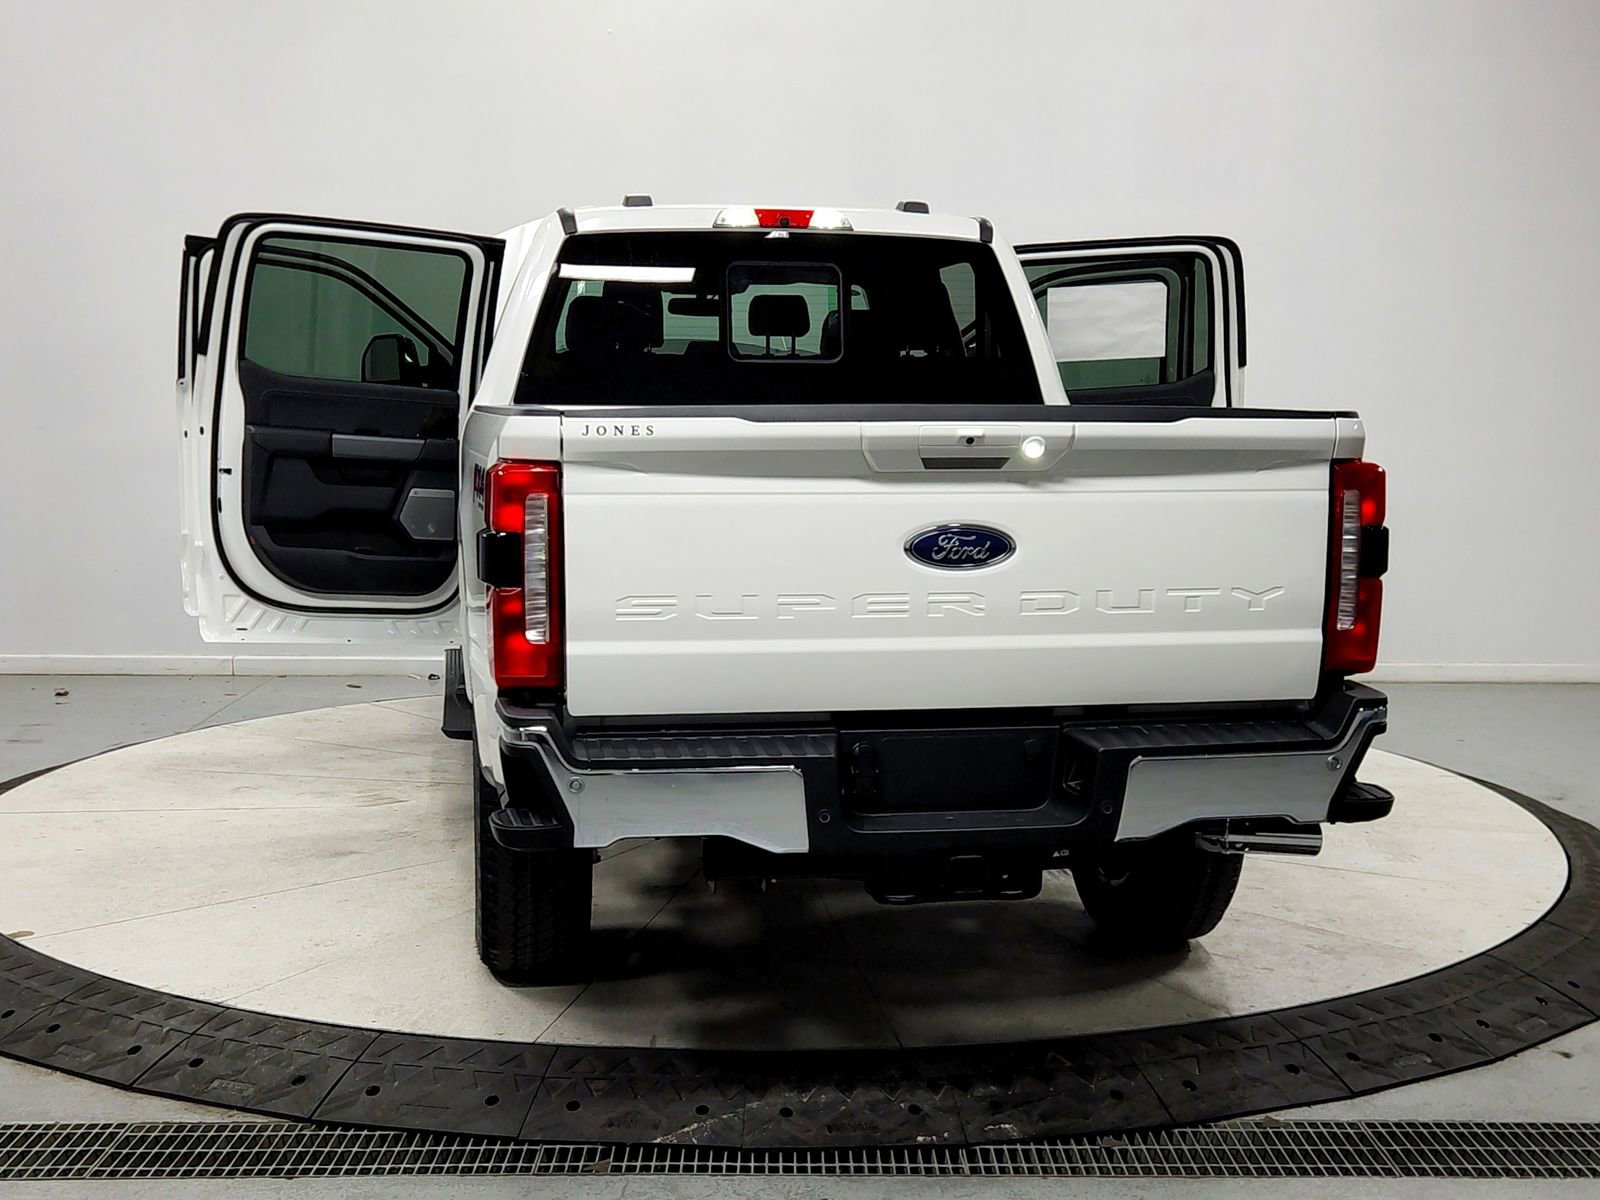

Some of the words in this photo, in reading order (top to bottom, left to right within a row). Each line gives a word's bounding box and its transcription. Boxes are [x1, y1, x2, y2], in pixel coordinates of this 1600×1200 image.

[581, 424, 655, 437] JONES
[931, 533, 991, 560] Ford
[615, 592, 985, 621] SUPER
[1018, 586, 1286, 616] DUTY
